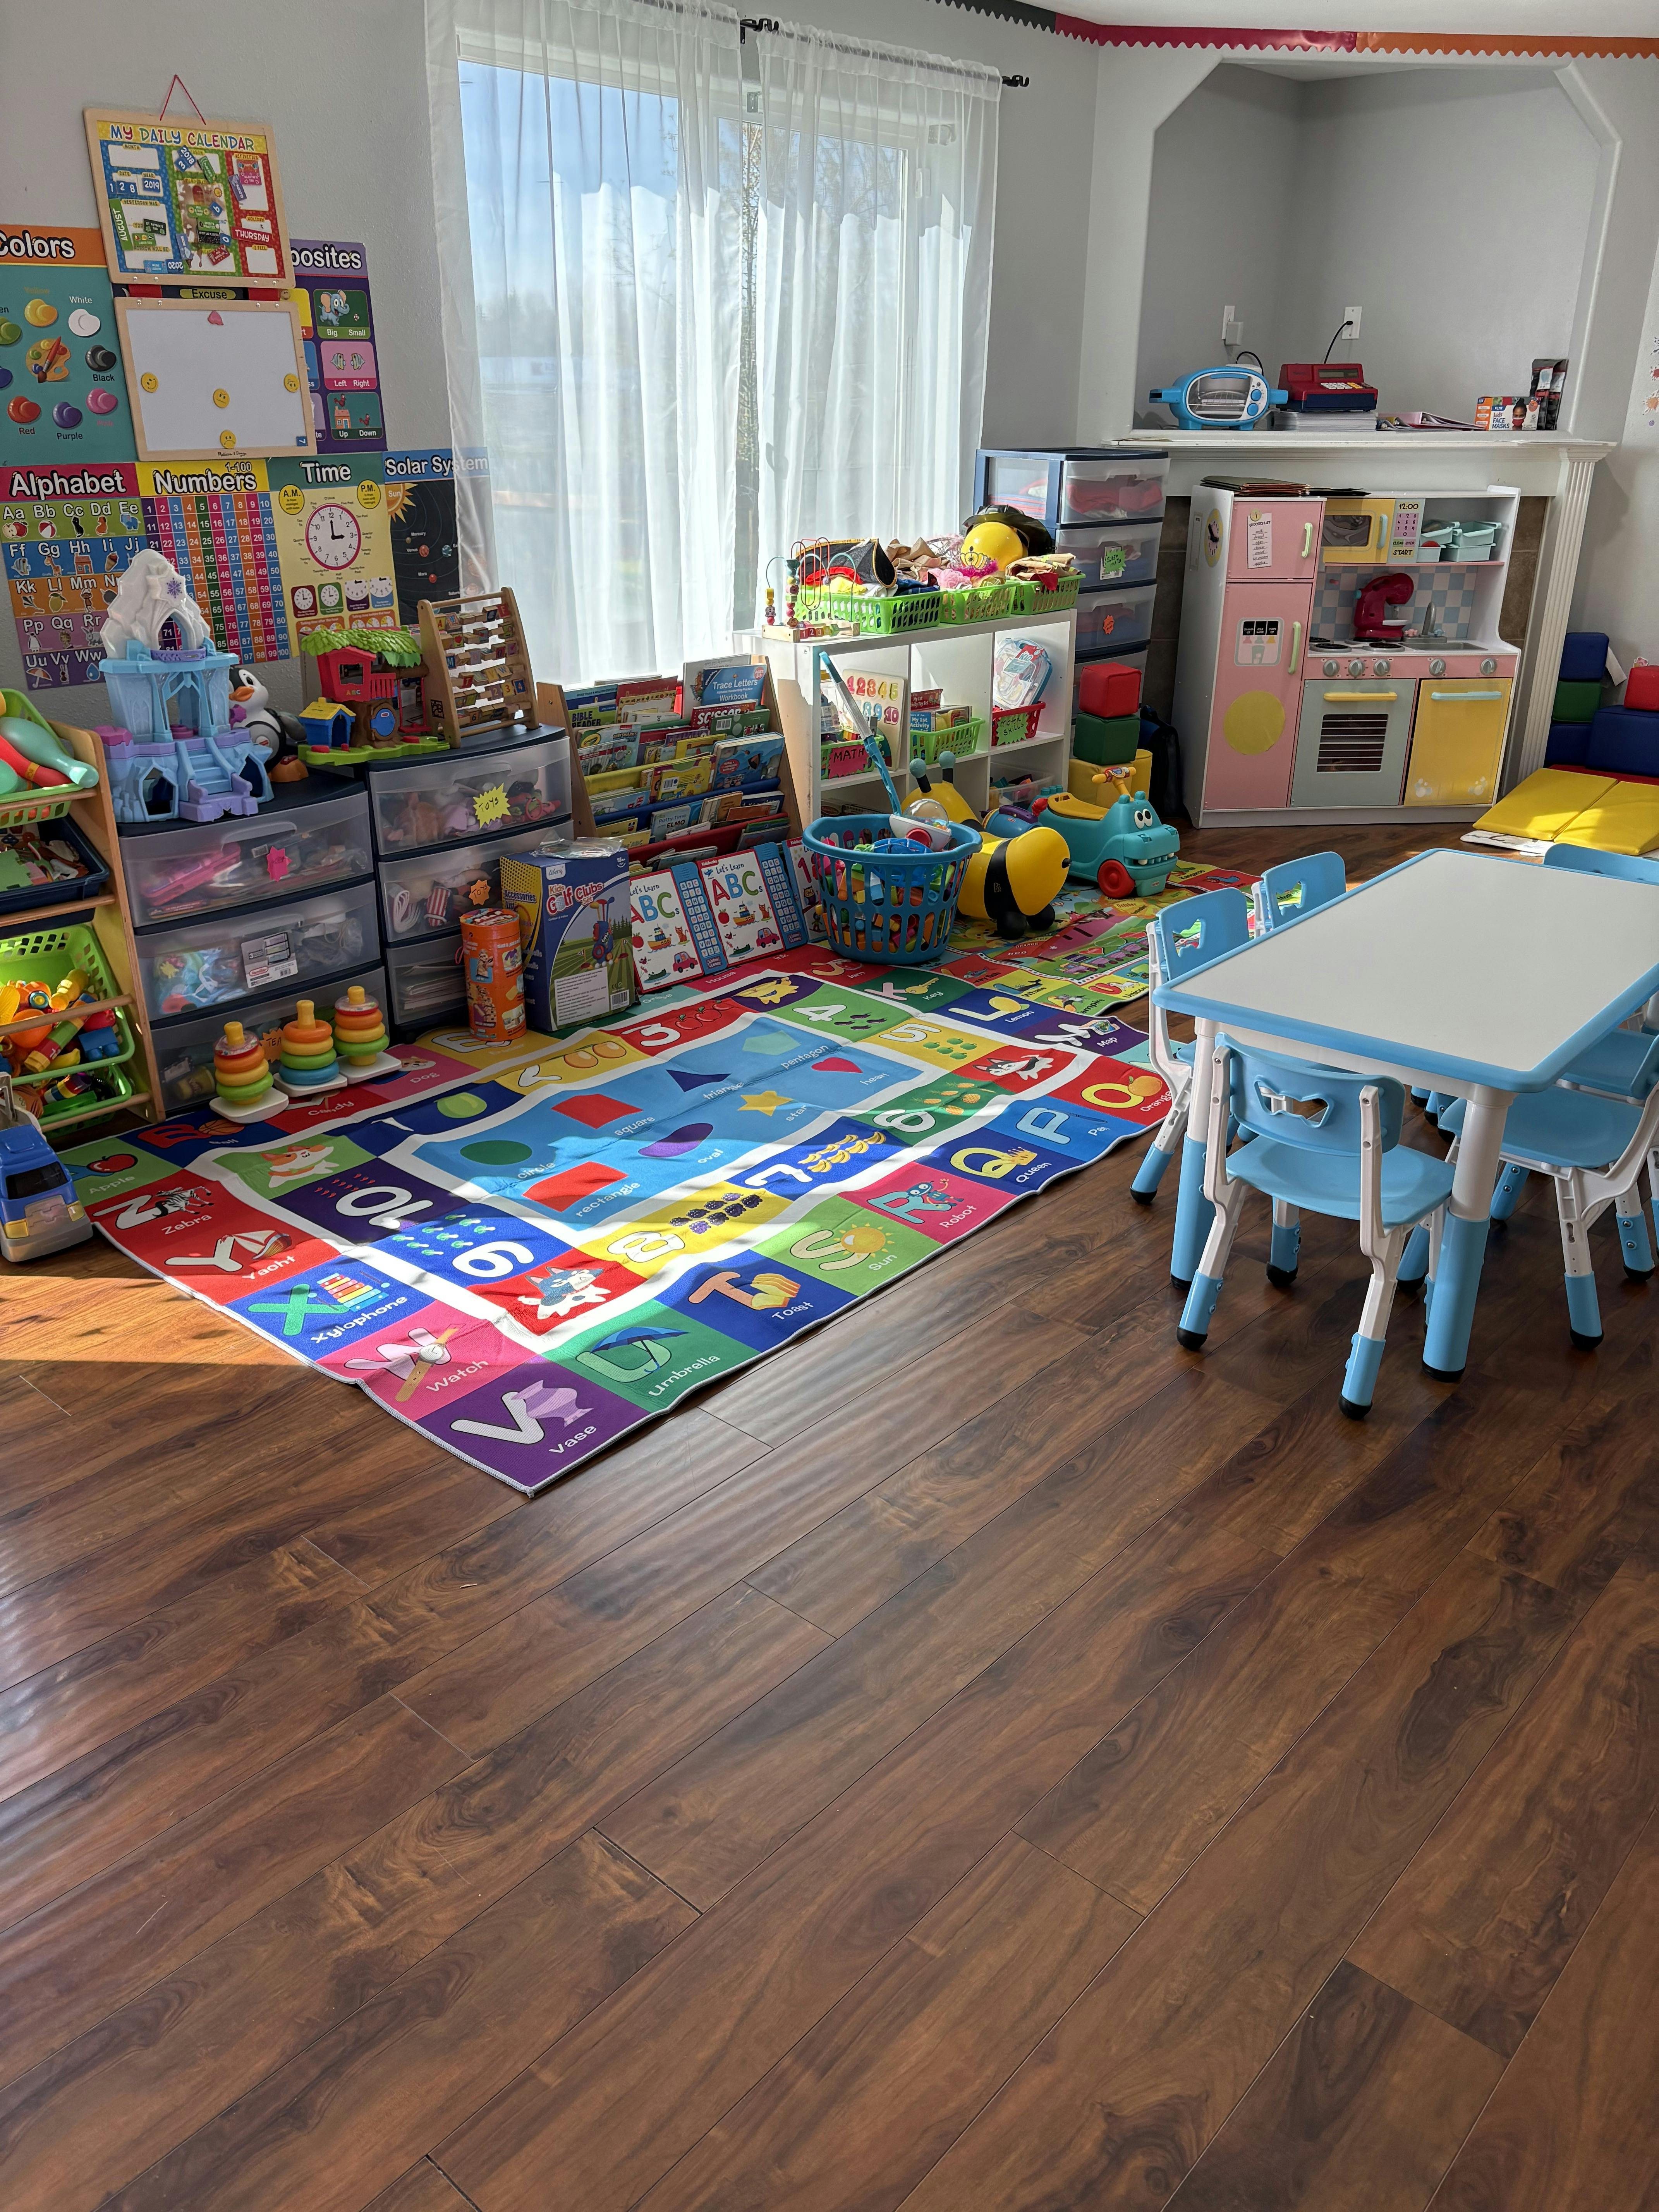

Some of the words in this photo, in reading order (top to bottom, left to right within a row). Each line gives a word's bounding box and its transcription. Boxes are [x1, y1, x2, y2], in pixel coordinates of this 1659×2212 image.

[111, 124, 133, 140] MY
[139, 127, 181, 144] DAILY
[188, 132, 254, 151] CALENDAR
[180, 147, 195, 164] 2018
[119, 182, 125, 191] 2
[130, 184, 135, 193] 8
[144, 180, 160, 189] 2019
[113, 208, 128, 241] AUGUST
[235, 229, 270, 242] THURSDAY
[69, 296, 93, 304] White
[192, 289, 227, 299] Excuse
[327, 329, 338, 338] Big
[353, 380, 370, 388] Right
[57, 432, 83, 440] Purple
[225, 462, 252, 472] 1-100
[301, 463, 351, 483] Time
[386, 458, 428, 476] Solar
[432, 457, 488, 476] System
[12, 471, 126, 500] Alphabet
[154, 470, 257, 494] Numbers
[3, 506, 25, 520] Aa
[33, 505, 56, 518] Bb
[63, 504, 84, 517] Cc
[91, 502, 112, 515] Dd
[119, 502, 138, 514] Ee
[720, 692, 748, 702] Workbook
[847, 675, 854, 694] 1
[856, 677, 866, 696] 2
[867, 679, 876, 697] 3
[878, 682, 887, 700] 4
[890, 683, 898, 701] 5
[572, 711, 593, 722] BIBLE
[572, 719, 601, 728] READER
[884, 706, 899, 725] 10
[833, 747, 865, 763] MATH
[666, 819, 685, 828] ELMO
[716, 865, 729, 874] Let's
[730, 863, 744, 871] Learn
[504, 891, 537, 903] Accessories
[549, 885, 564, 893] Kids
[576, 883, 603, 900] Clubs
[643, 884, 659, 892] Learn
[712, 871, 763, 906] ABCs
[583, 896, 593, 905] Set
[705, 970, 737, 984] House
[922, 991, 944, 1001] Key
[792, 1004, 847, 1022] 4
[1004, 1010, 1034, 1023] Lemon
[1097, 1036, 1117, 1048] Map
[780, 1044, 830, 1071] pentagon
[410, 1071, 440, 1084] Dog
[860, 1072, 888, 1086] heart
[702, 1081, 745, 1101] triangle
[1080, 1083, 1145, 1109] O
[307, 1099, 355, 1117] Candy
[1140, 1091, 1171, 1113] Orange
[784, 1104, 808, 1122] star
[613, 1115, 656, 1137] square
[697, 1148, 723, 1165] oval
[516, 1161, 556, 1181] circle
[1015, 1162, 1053, 1184] Queen
[89, 1175, 136, 1195] Apple
[575, 1181, 641, 1218] rectangle
[161, 1213, 213, 1236] Zebra
[939, 1204, 977, 1228] Robot
[242, 1255, 295, 1281] Yacht
[867, 1252, 898, 1272] Sun
[310, 1293, 409, 1345] Xylophone
[771, 1300, 815, 1321] Toast
[425, 1358, 490, 1394] Watch
[647, 1353, 721, 1397] Umbrella
[548, 1423, 598, 1456] Vase
